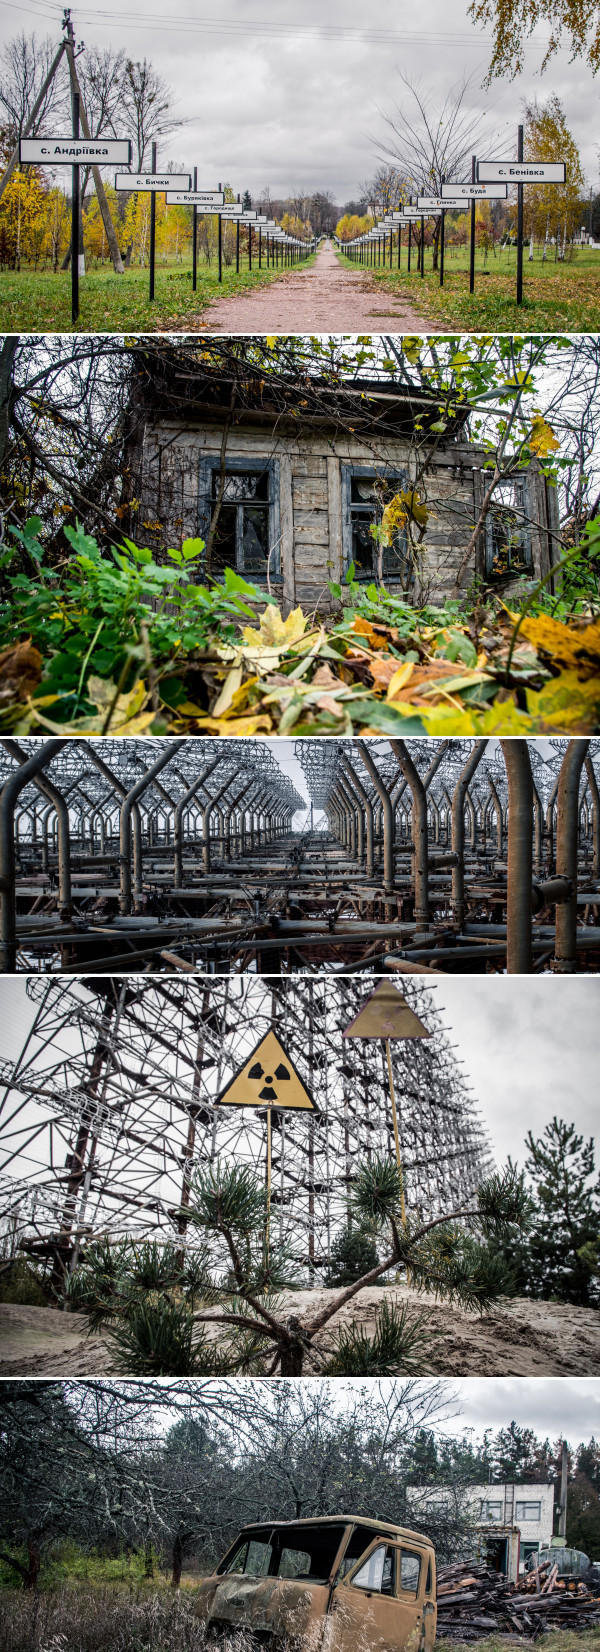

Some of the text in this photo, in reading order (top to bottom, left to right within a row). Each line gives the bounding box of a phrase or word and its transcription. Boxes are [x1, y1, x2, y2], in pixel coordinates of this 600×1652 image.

[40, 146, 109, 157] с. Андріївка
[509, 168, 545, 176] Бенівка
[469, 187, 487, 195] Буда
